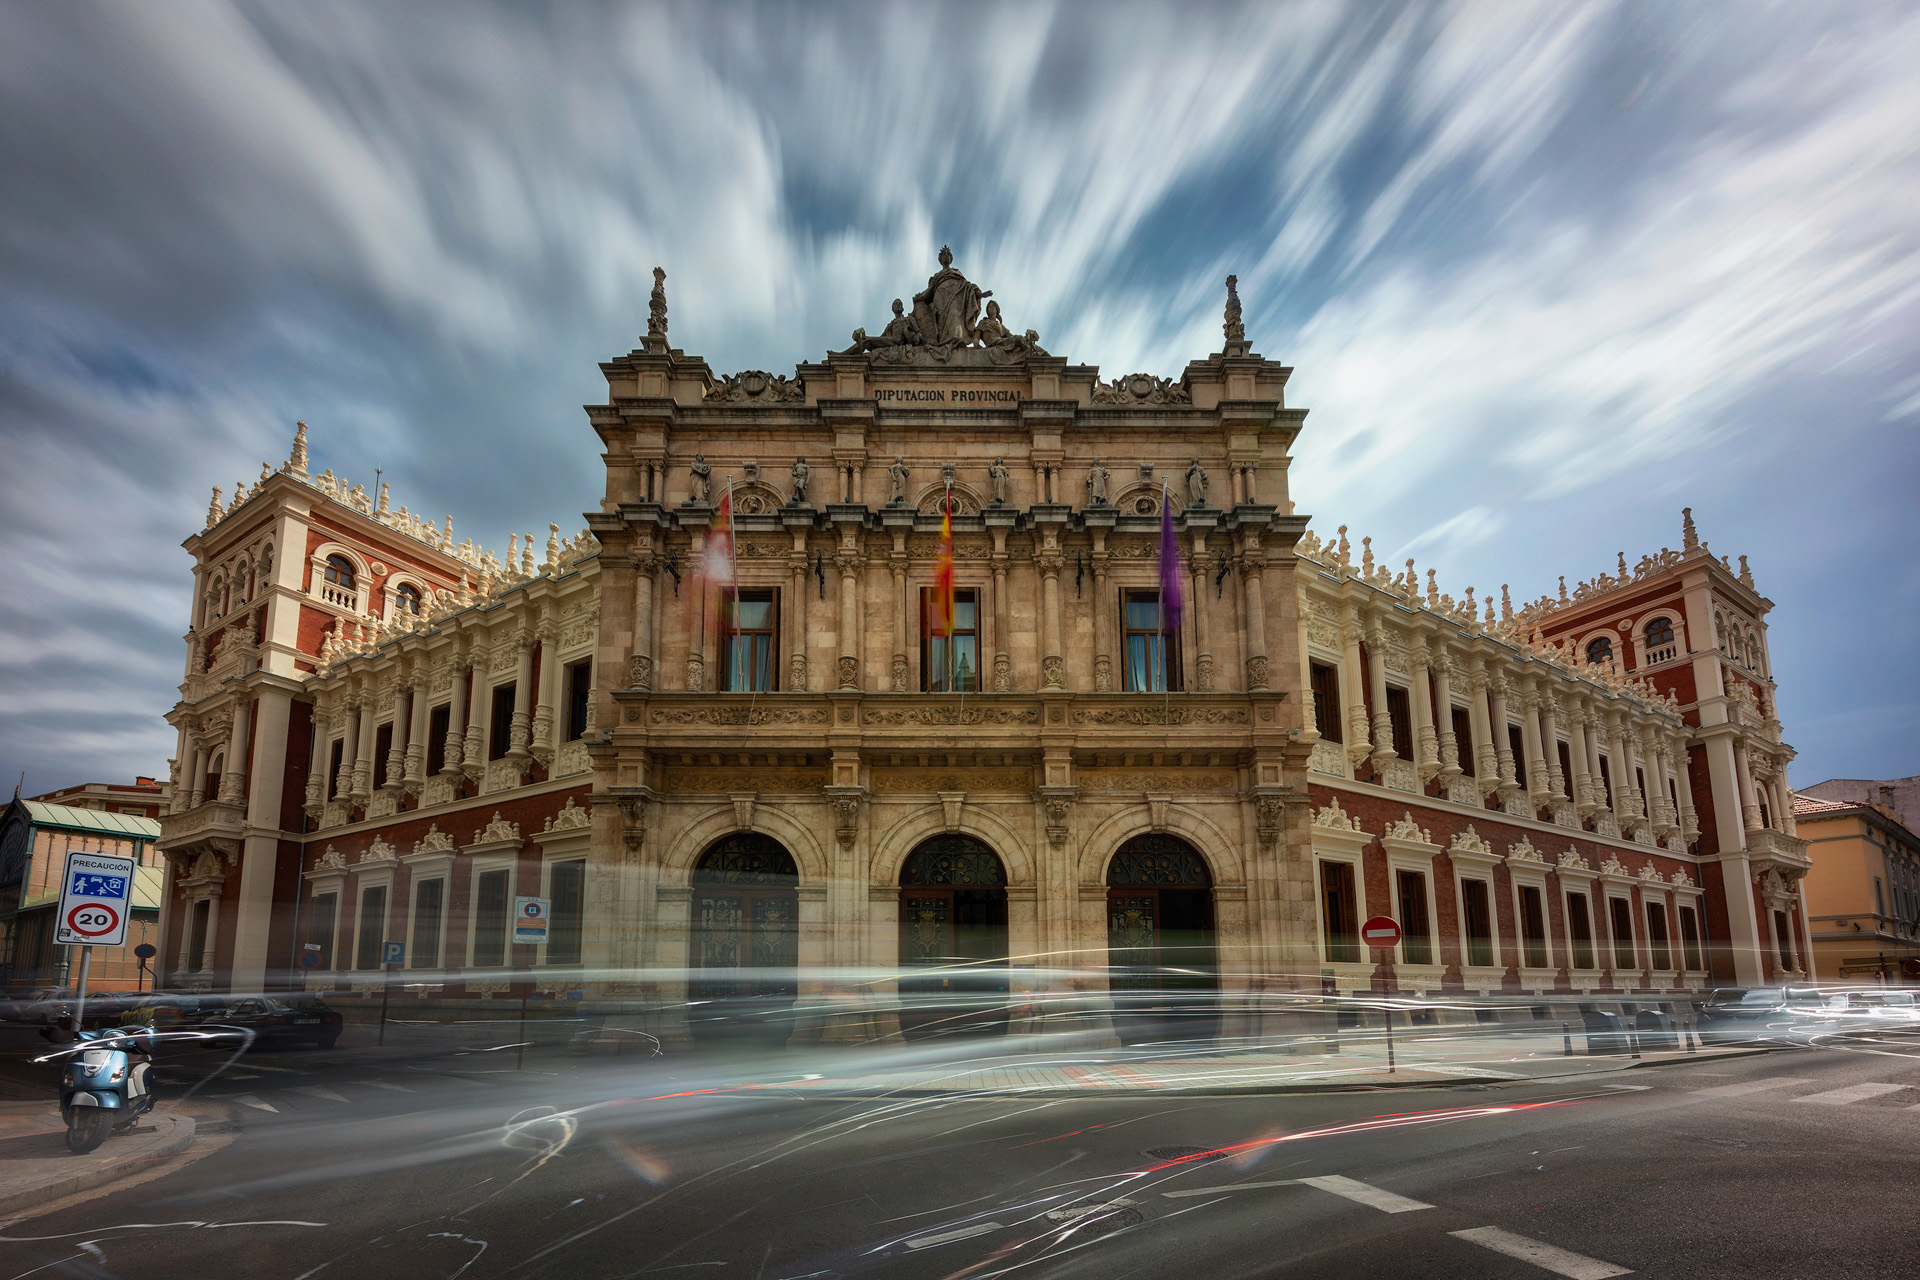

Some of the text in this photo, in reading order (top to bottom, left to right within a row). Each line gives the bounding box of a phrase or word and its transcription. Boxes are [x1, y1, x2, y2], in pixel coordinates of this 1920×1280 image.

[874, 389, 945, 401] DIPUTACION
[73, 859, 129, 872] PRECAUCIÓN
[79, 913, 108, 926] 20
[387, 944, 401, 961] P
